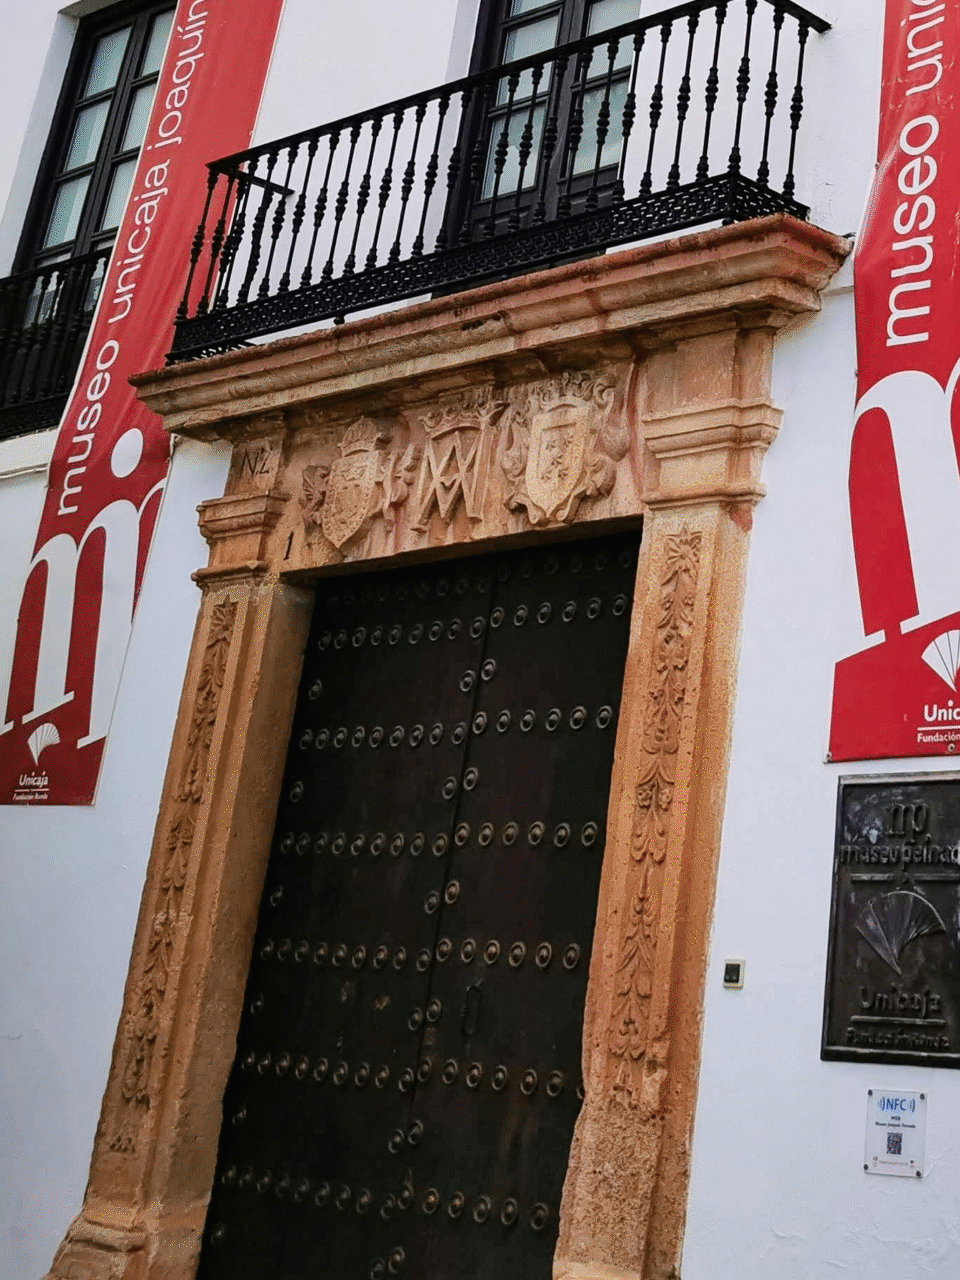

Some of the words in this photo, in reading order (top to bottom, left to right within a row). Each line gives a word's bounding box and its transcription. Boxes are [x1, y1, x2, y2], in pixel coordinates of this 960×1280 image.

[886, 114, 939, 348] museo
[57, 338, 119, 516] museo
[108, 159, 171, 324] unicaja
[19, 770, 49, 789] Unicaja
[860, 982, 942, 1018] Unicaja
[886, 1097, 907, 1111] NFC
